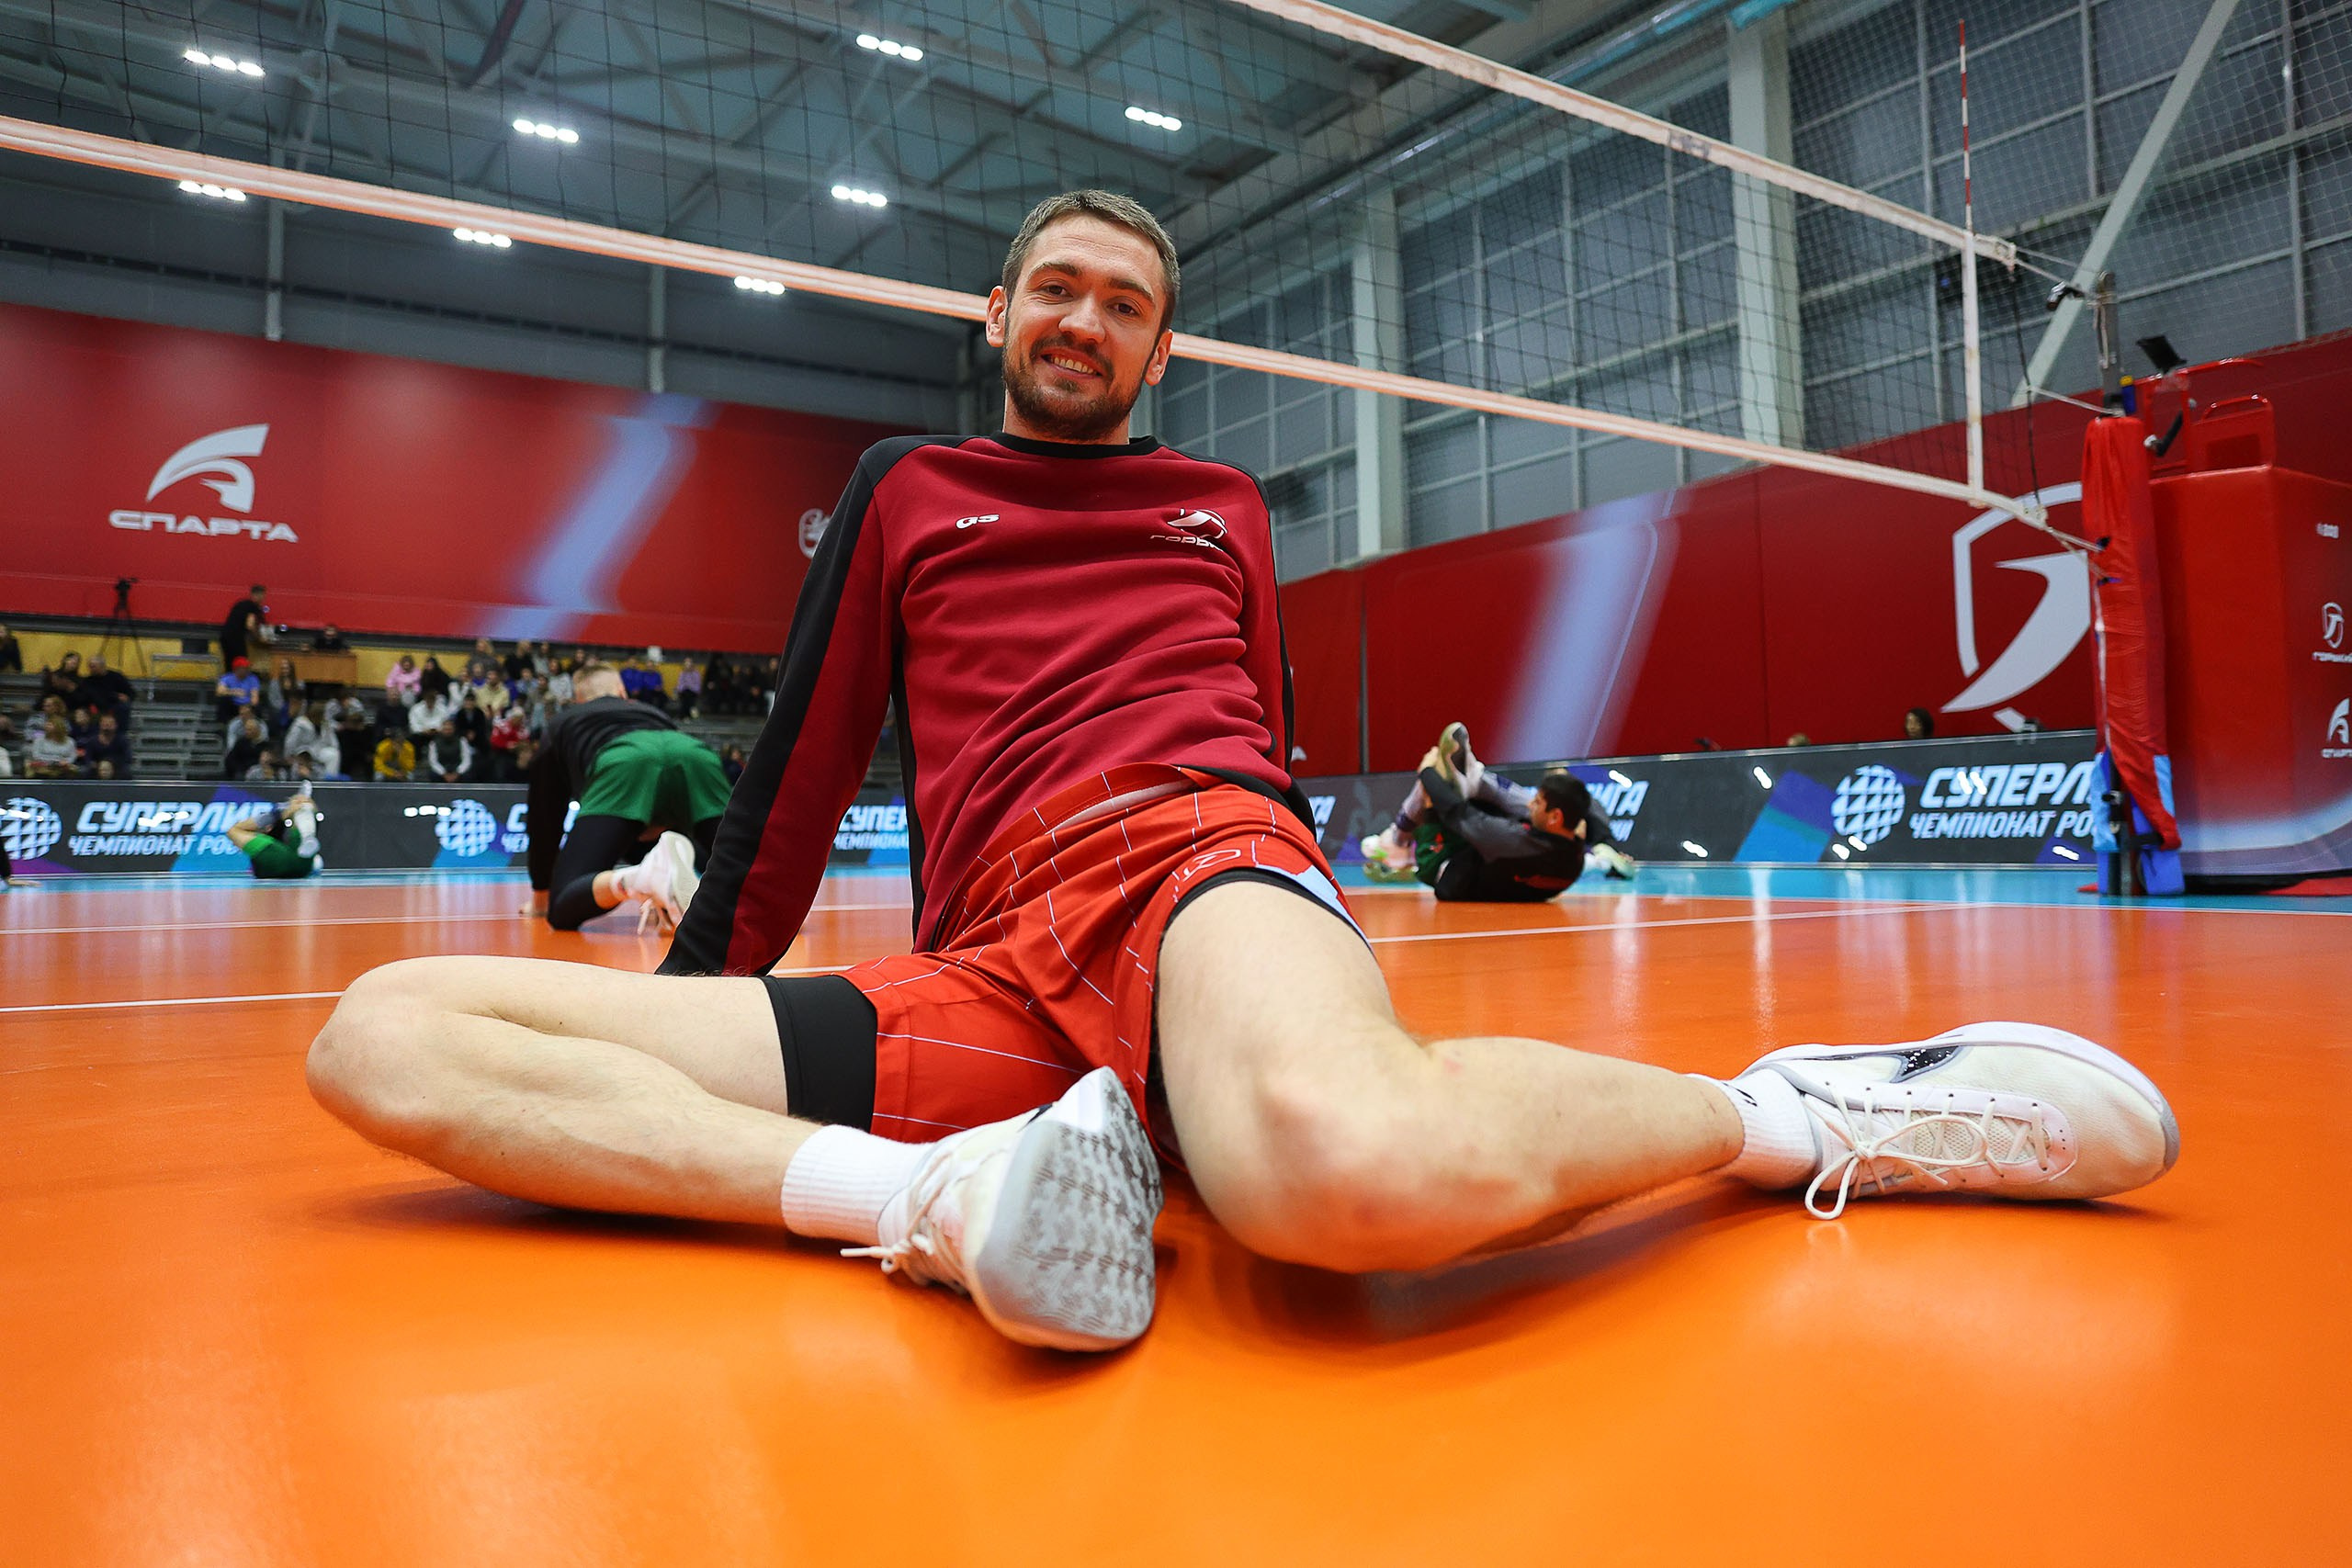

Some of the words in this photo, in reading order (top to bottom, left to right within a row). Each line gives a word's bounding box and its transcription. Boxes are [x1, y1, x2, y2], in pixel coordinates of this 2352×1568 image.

[108, 509, 300, 544] СПАРТА
[956, 513, 1000, 529] GS
[1919, 761, 2095, 808] СУПЕРЛ
[1909, 809, 2057, 840] ЧЕМПИОНАТ
[69, 834, 198, 855] ЧЕМПИОНАТ
